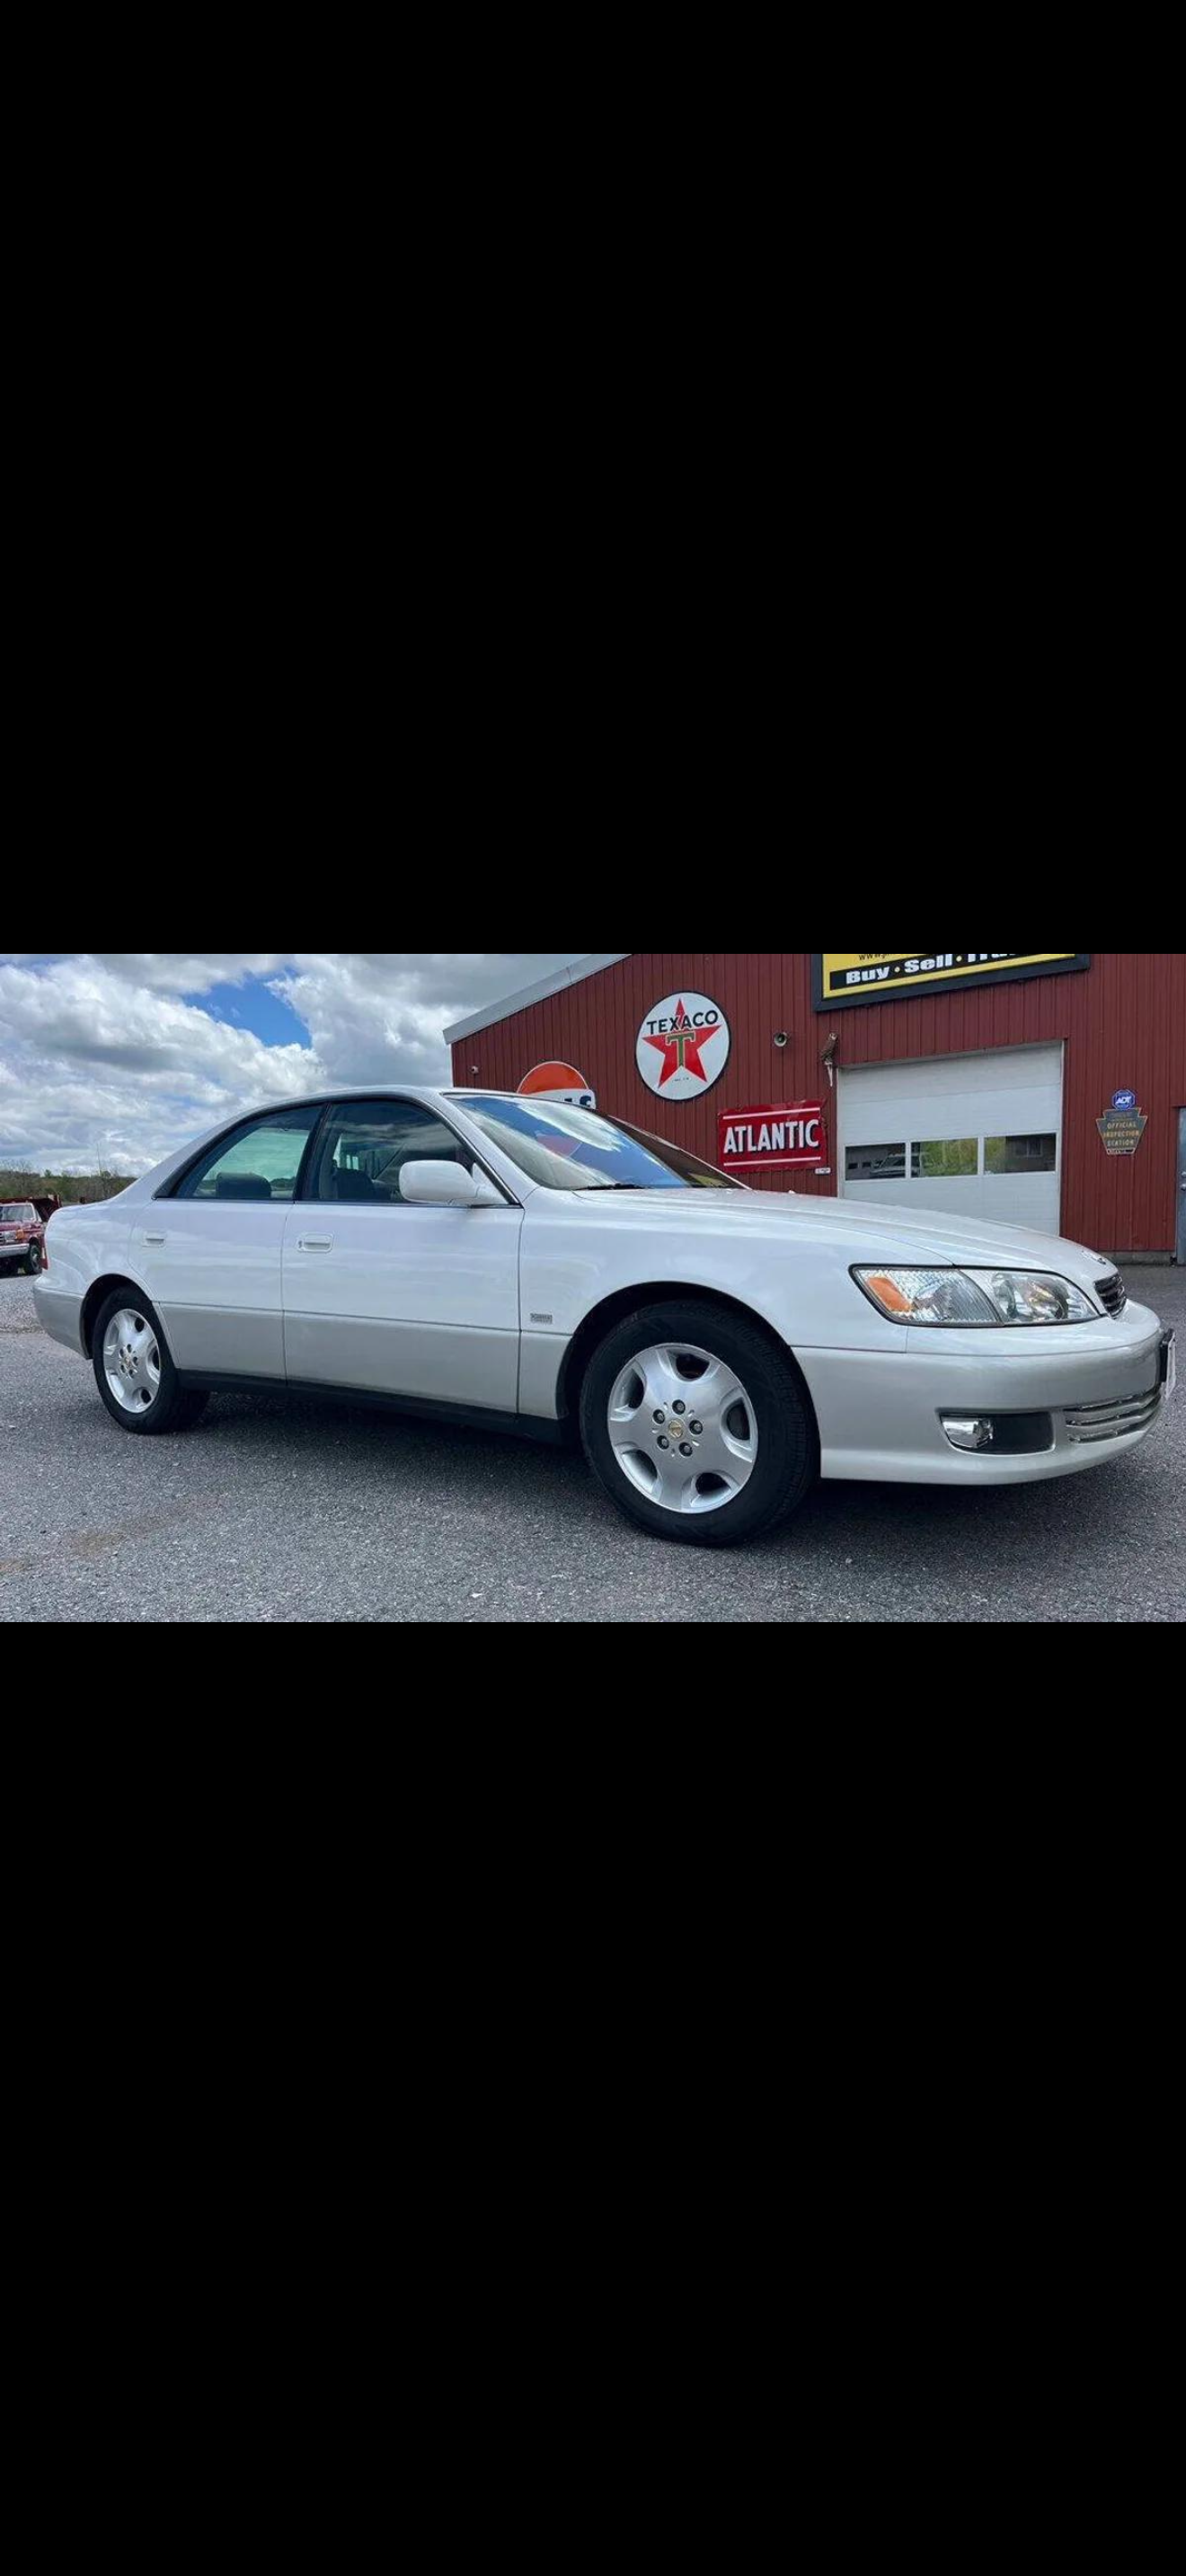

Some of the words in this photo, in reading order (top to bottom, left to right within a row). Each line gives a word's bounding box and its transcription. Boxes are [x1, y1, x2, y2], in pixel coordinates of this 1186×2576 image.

[845, 966, 890, 984] Buy
[904, 954, 953, 974] Sell
[646, 1010, 719, 1035] TEXACO
[1115, 1096, 1132, 1105] ADT
[723, 1118, 820, 1154] ATLANTIC
[1107, 1121, 1137, 1130] OFFICIAL
